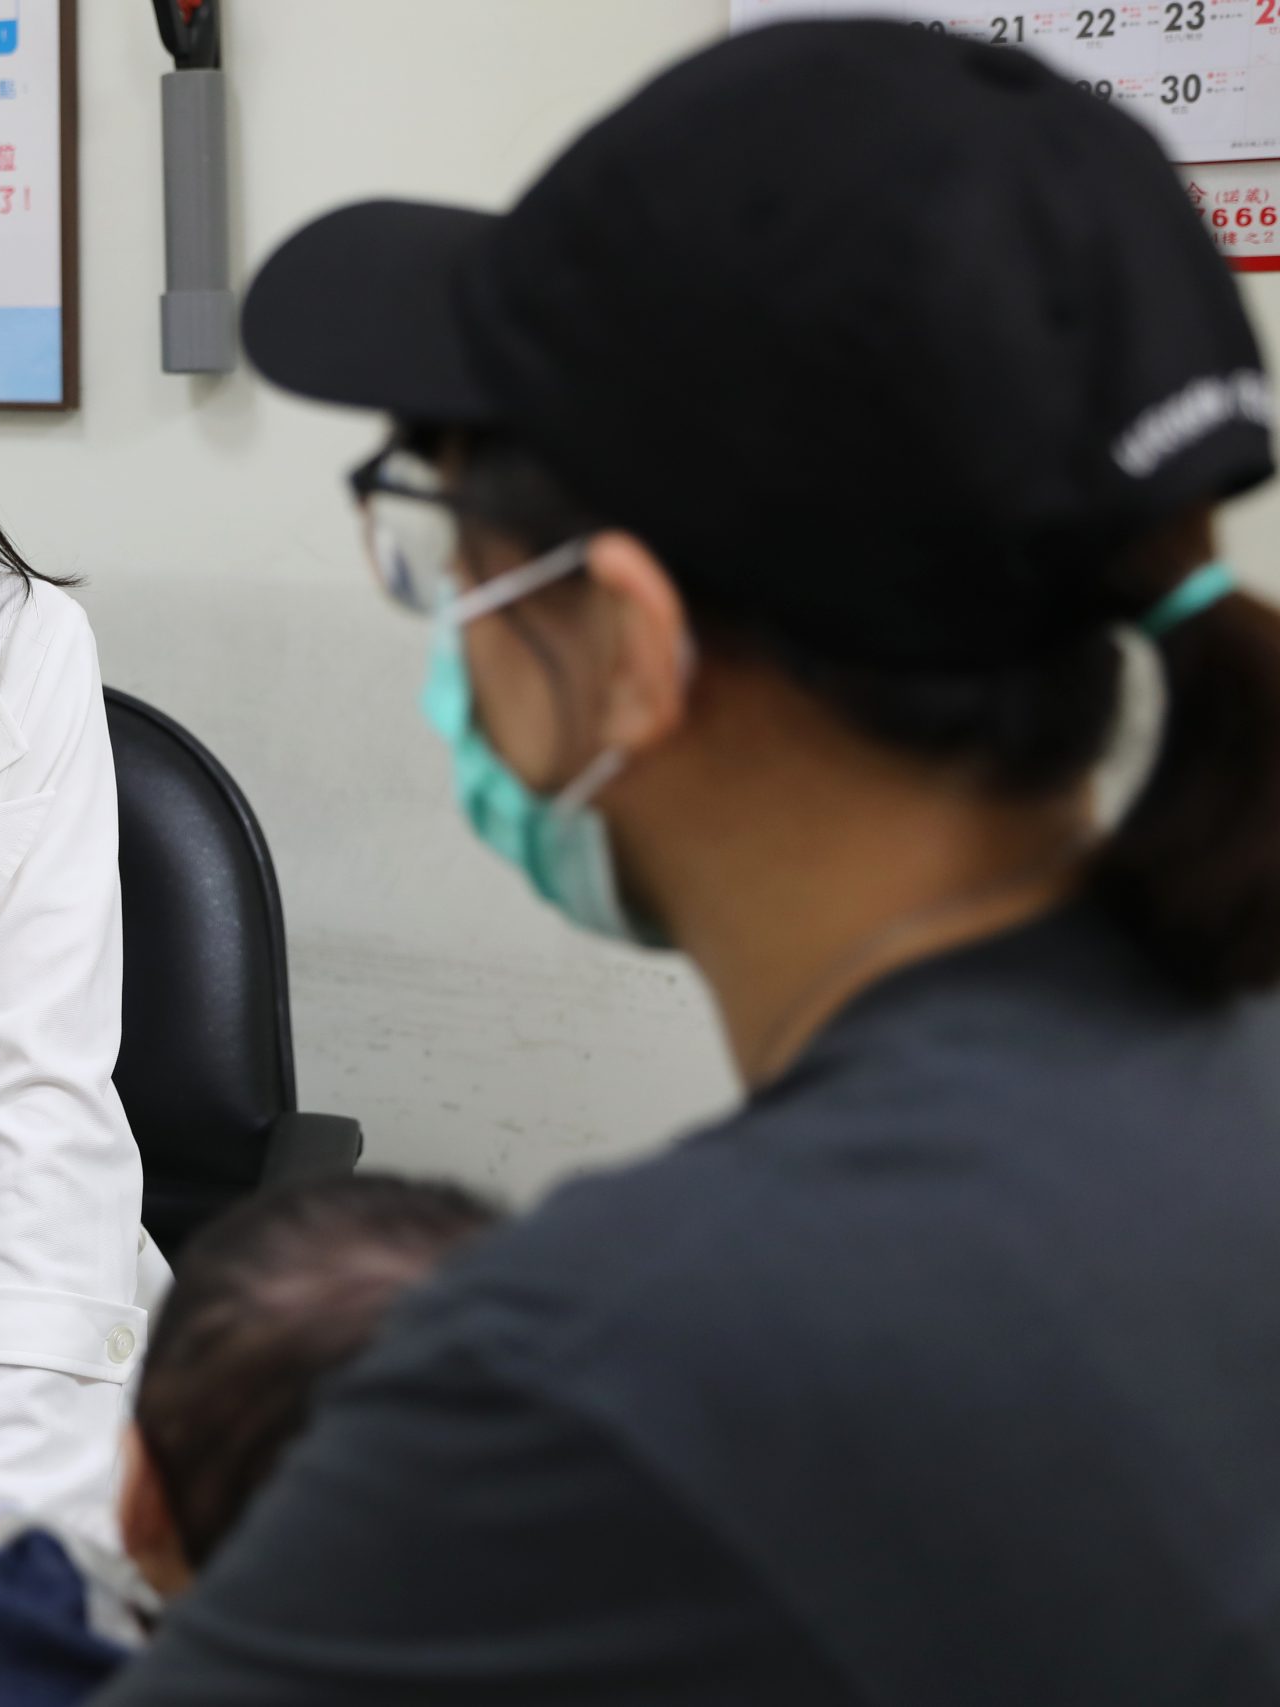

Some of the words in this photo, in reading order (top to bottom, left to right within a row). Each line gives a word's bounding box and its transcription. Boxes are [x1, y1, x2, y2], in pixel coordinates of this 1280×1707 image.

[1076, 10, 1116, 39] 22
[1164, 1, 1206, 32] 23
[1255, 0, 1280, 25] 2
[989, 16, 1024, 44] 21
[1160, 73, 1202, 105] 30
